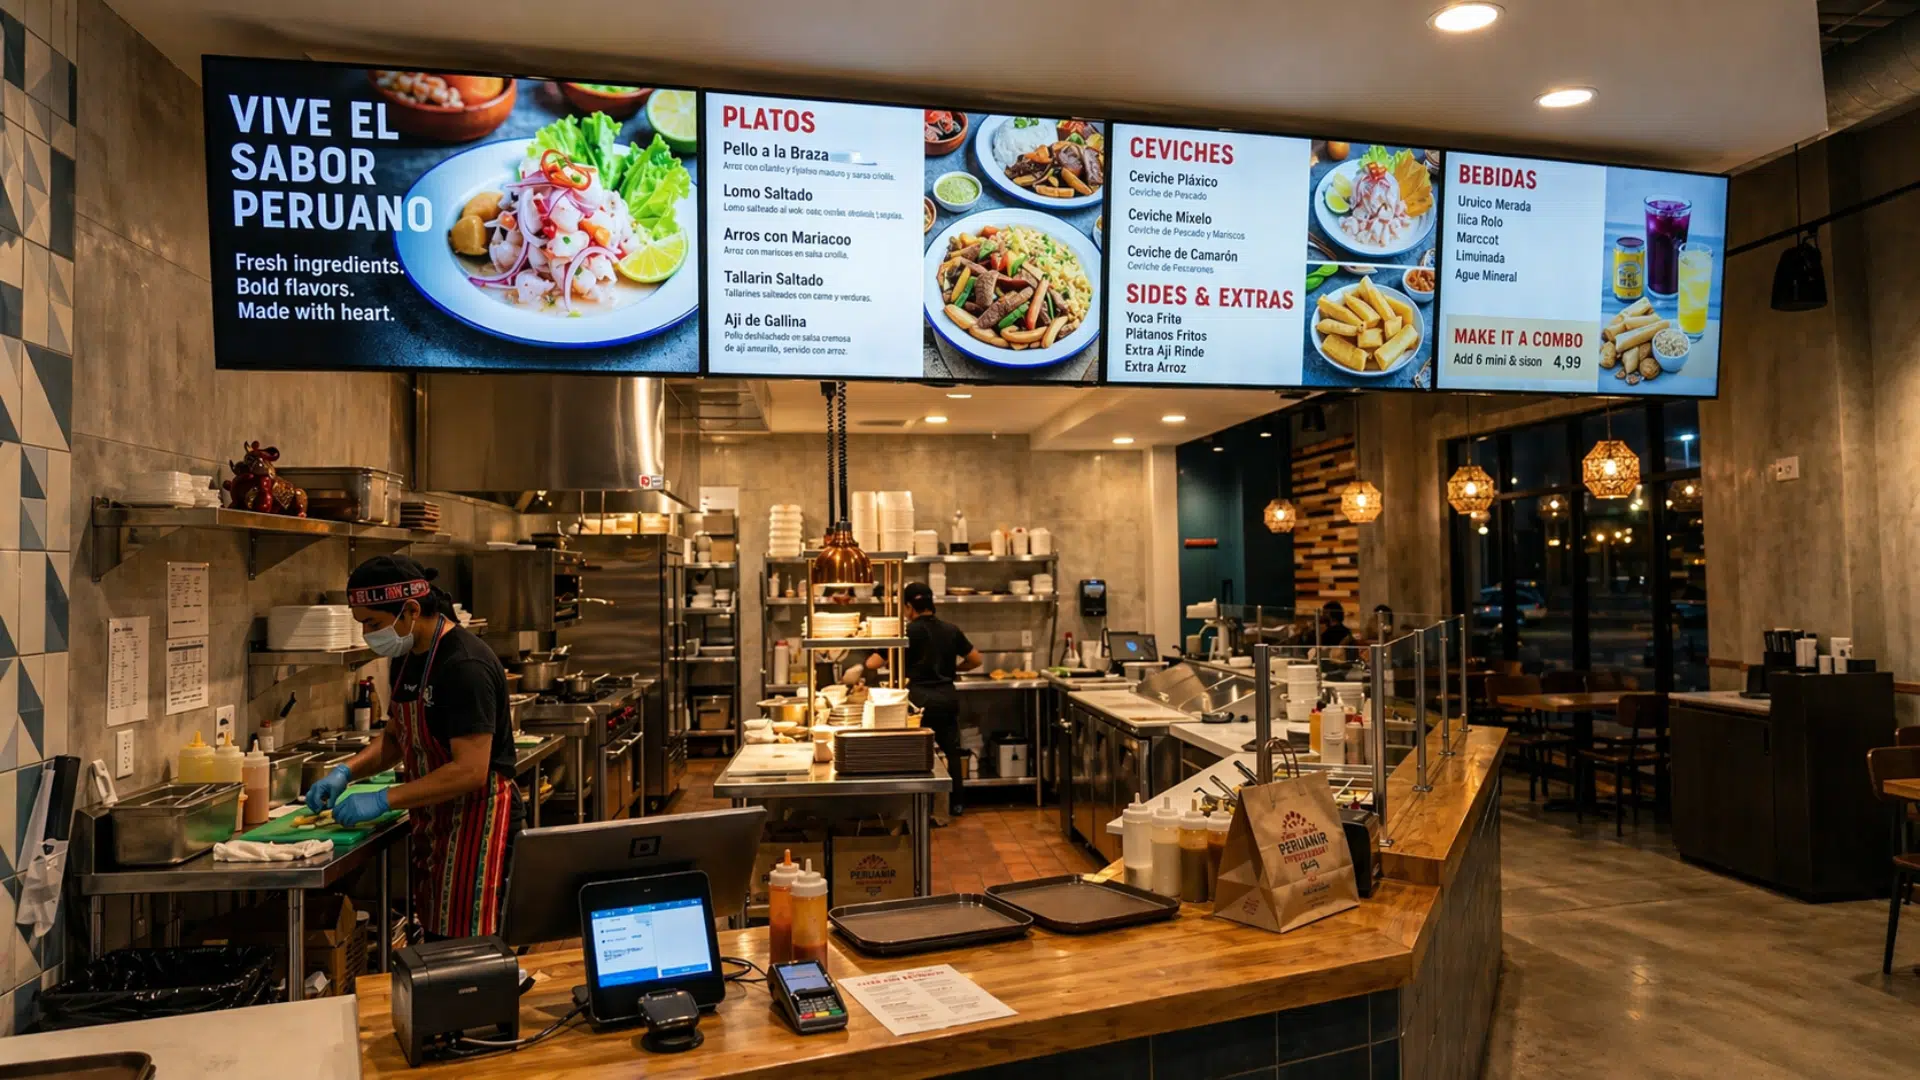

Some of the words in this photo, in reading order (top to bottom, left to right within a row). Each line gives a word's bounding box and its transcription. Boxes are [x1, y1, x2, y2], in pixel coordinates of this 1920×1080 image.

[229, 94, 331, 136] VIVE
[351, 101, 399, 140] EL
[723, 105, 815, 133] PLATOS
[724, 141, 757, 156] Pello
[762, 147, 769, 157] a
[774, 144, 786, 159] la
[791, 146, 829, 161] Braza
[1130, 137, 1234, 165] CEVICHES
[231, 143, 376, 185] SABOR
[744, 164, 758, 172] con
[785, 167, 790, 175] y
[1130, 170, 1174, 184] Ceviche
[1178, 173, 1218, 187] Pláxico
[1459, 164, 1537, 190] BEBIDAS
[724, 184, 760, 198] Lomo
[765, 187, 813, 201] Saltado
[1129, 187, 1161, 197] Ceviche
[1163, 190, 1173, 198] de
[1175, 190, 1207, 200] Pescado
[233, 190, 434, 233] PERUANO
[724, 203, 745, 212] Lomo
[1458, 195, 1492, 209] Uruico
[1495, 199, 1531, 212] Merada
[1129, 208, 1172, 222] Ceviche
[1176, 211, 1212, 224] Mixelo
[1481, 215, 1503, 227] Rolo
[724, 228, 759, 241] Arros
[764, 233, 787, 243] con
[792, 231, 851, 246] Mariacoo
[1128, 225, 1160, 235] Ceviche
[1162, 227, 1172, 236] de
[1174, 228, 1205, 238] Pescado
[1213, 230, 1245, 240] Mariscos
[1457, 232, 1499, 245] Marccot
[724, 246, 744, 255] Arroz
[1128, 245, 1171, 258] Ceviche
[1175, 248, 1187, 259] de
[1191, 249, 1237, 262] Camarón
[236, 253, 287, 272] Fresh
[294, 255, 405, 278] ingredients.
[724, 271, 772, 284] Tallarin
[776, 273, 823, 286] Saltado
[1455, 269, 1479, 282] Ague
[1482, 270, 1517, 282] Mineral
[237, 278, 281, 295] Bold
[285, 279, 354, 297] flavors.
[725, 289, 760, 298] Tallarines
[1127, 284, 1187, 305] SIDES
[1195, 287, 1210, 306] &
[1220, 288, 1294, 310] EXTRAS
[238, 302, 290, 319] Made
[295, 303, 335, 320] with
[341, 303, 395, 321] heart.
[1126, 312, 1153, 323] Yoca
[1157, 313, 1181, 324] Frite
[725, 313, 741, 329] Aji
[745, 314, 760, 326] de
[765, 315, 806, 327] Gallina
[1126, 328, 1173, 340] Plátanos
[1177, 330, 1207, 341] Fritos
[1455, 328, 1496, 344] MAKE
[1502, 330, 1514, 345] IT
[1518, 331, 1527, 345] A
[1533, 332, 1583, 348] COMBO
[725, 344, 734, 352] de
[783, 346, 810, 354] servido
[1126, 344, 1154, 356] Extra
[1175, 346, 1204, 357] Rinde
[1125, 360, 1153, 372] Extra
[1157, 362, 1186, 373] Arroz
[1454, 353, 1473, 364] Add
[1476, 354, 1482, 365] 6
[1486, 355, 1506, 365] mini
[1509, 355, 1516, 366] &
[1519, 356, 1542, 366] sison
[1554, 356, 1581, 370] 4,99
[1279, 832, 1328, 855] PERUANIR
